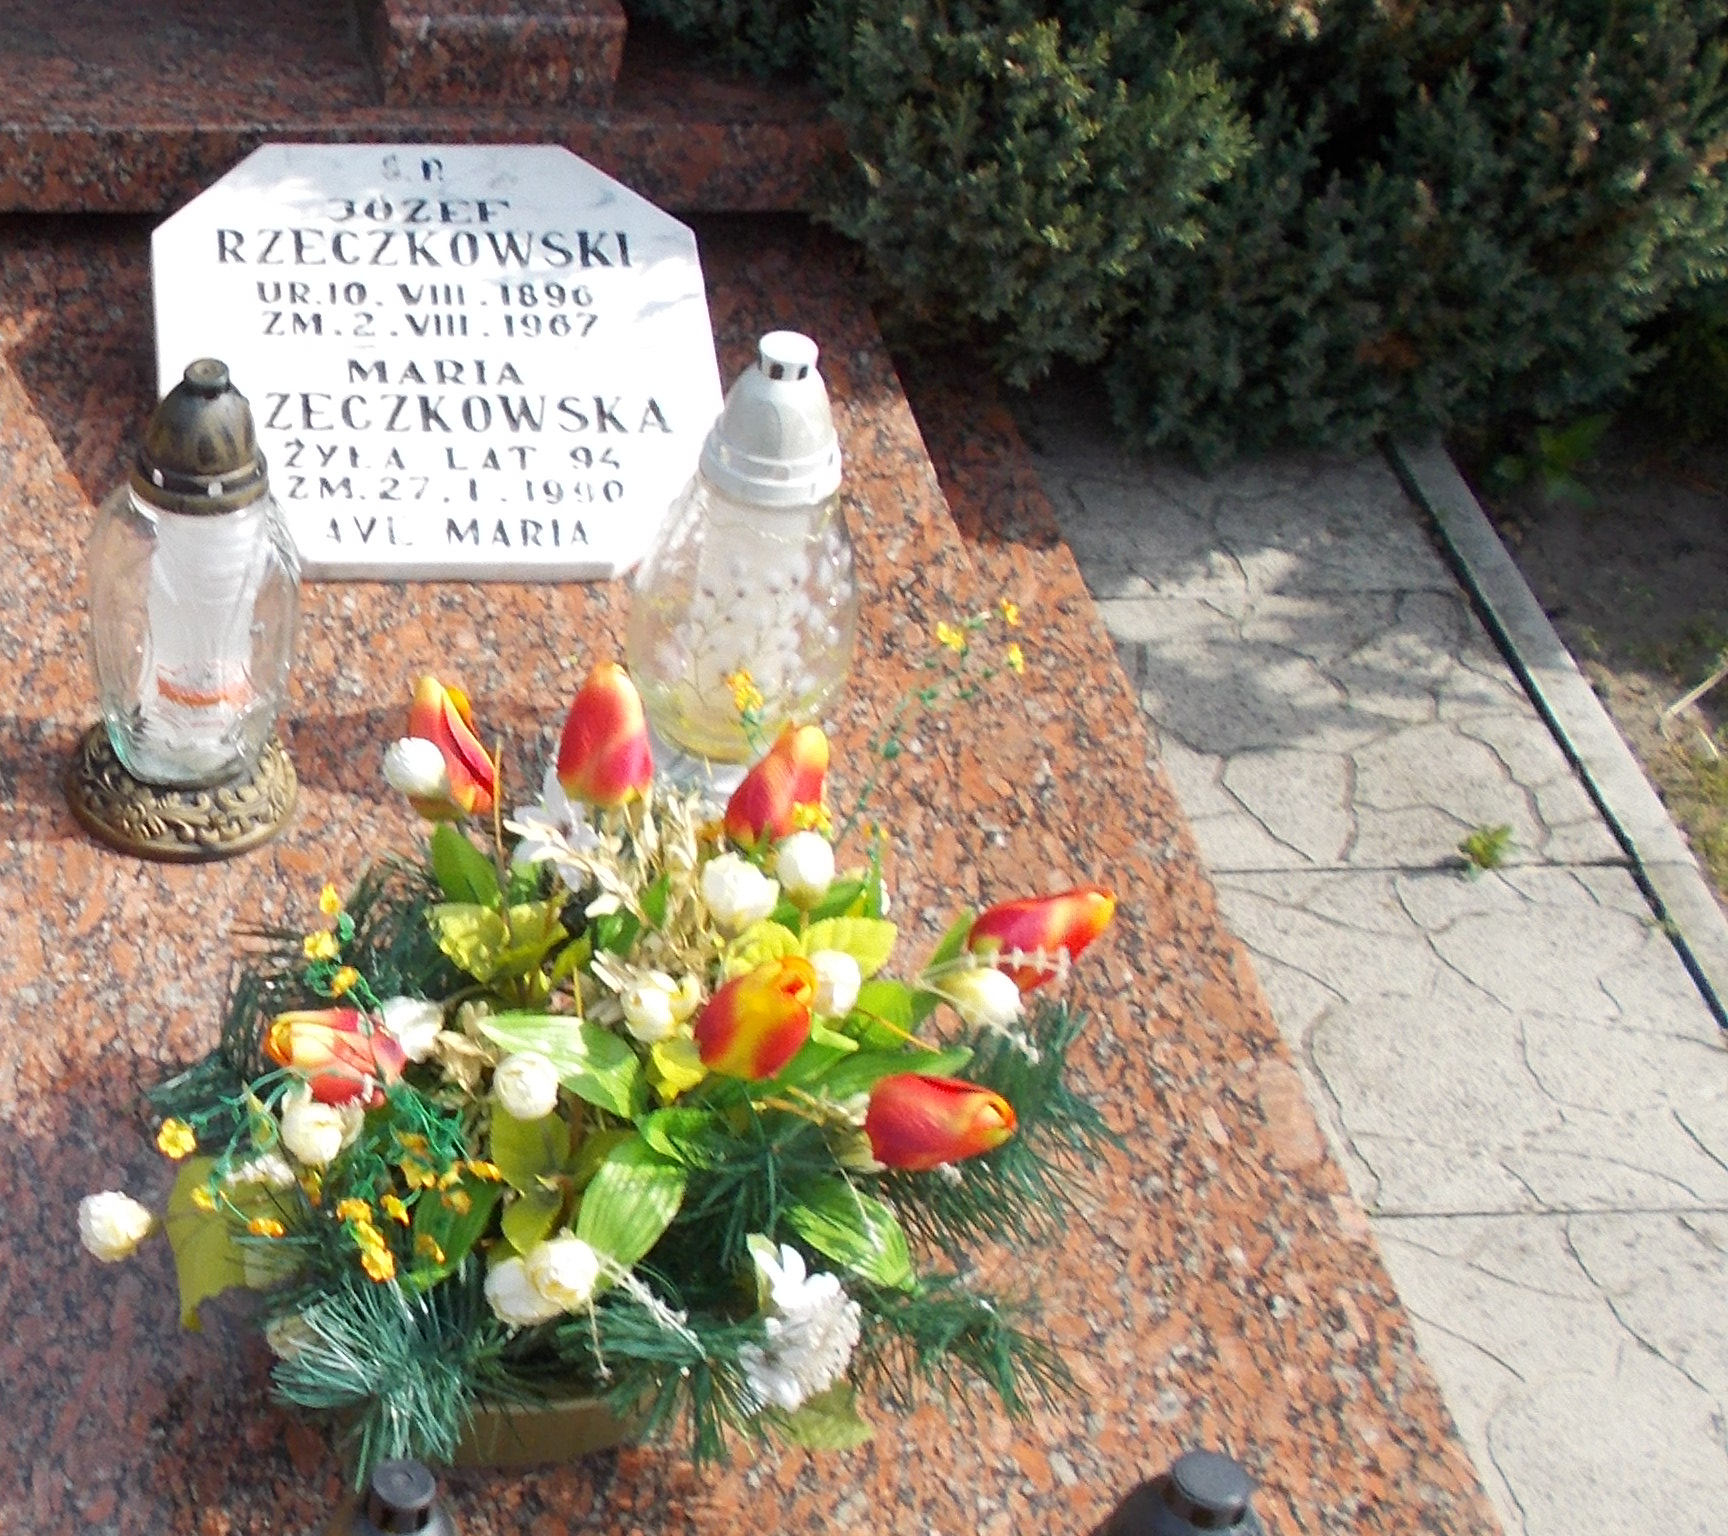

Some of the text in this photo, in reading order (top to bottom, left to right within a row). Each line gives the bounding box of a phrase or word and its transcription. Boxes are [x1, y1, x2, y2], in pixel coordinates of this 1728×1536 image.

[216, 226, 632, 268] RZECZKOWSKI
[347, 358, 525, 386] MARIA
[263, 392, 675, 434] ZECZKOWSKA
[444, 445, 538, 472] LAT
[445, 517, 590, 548] MARIA
